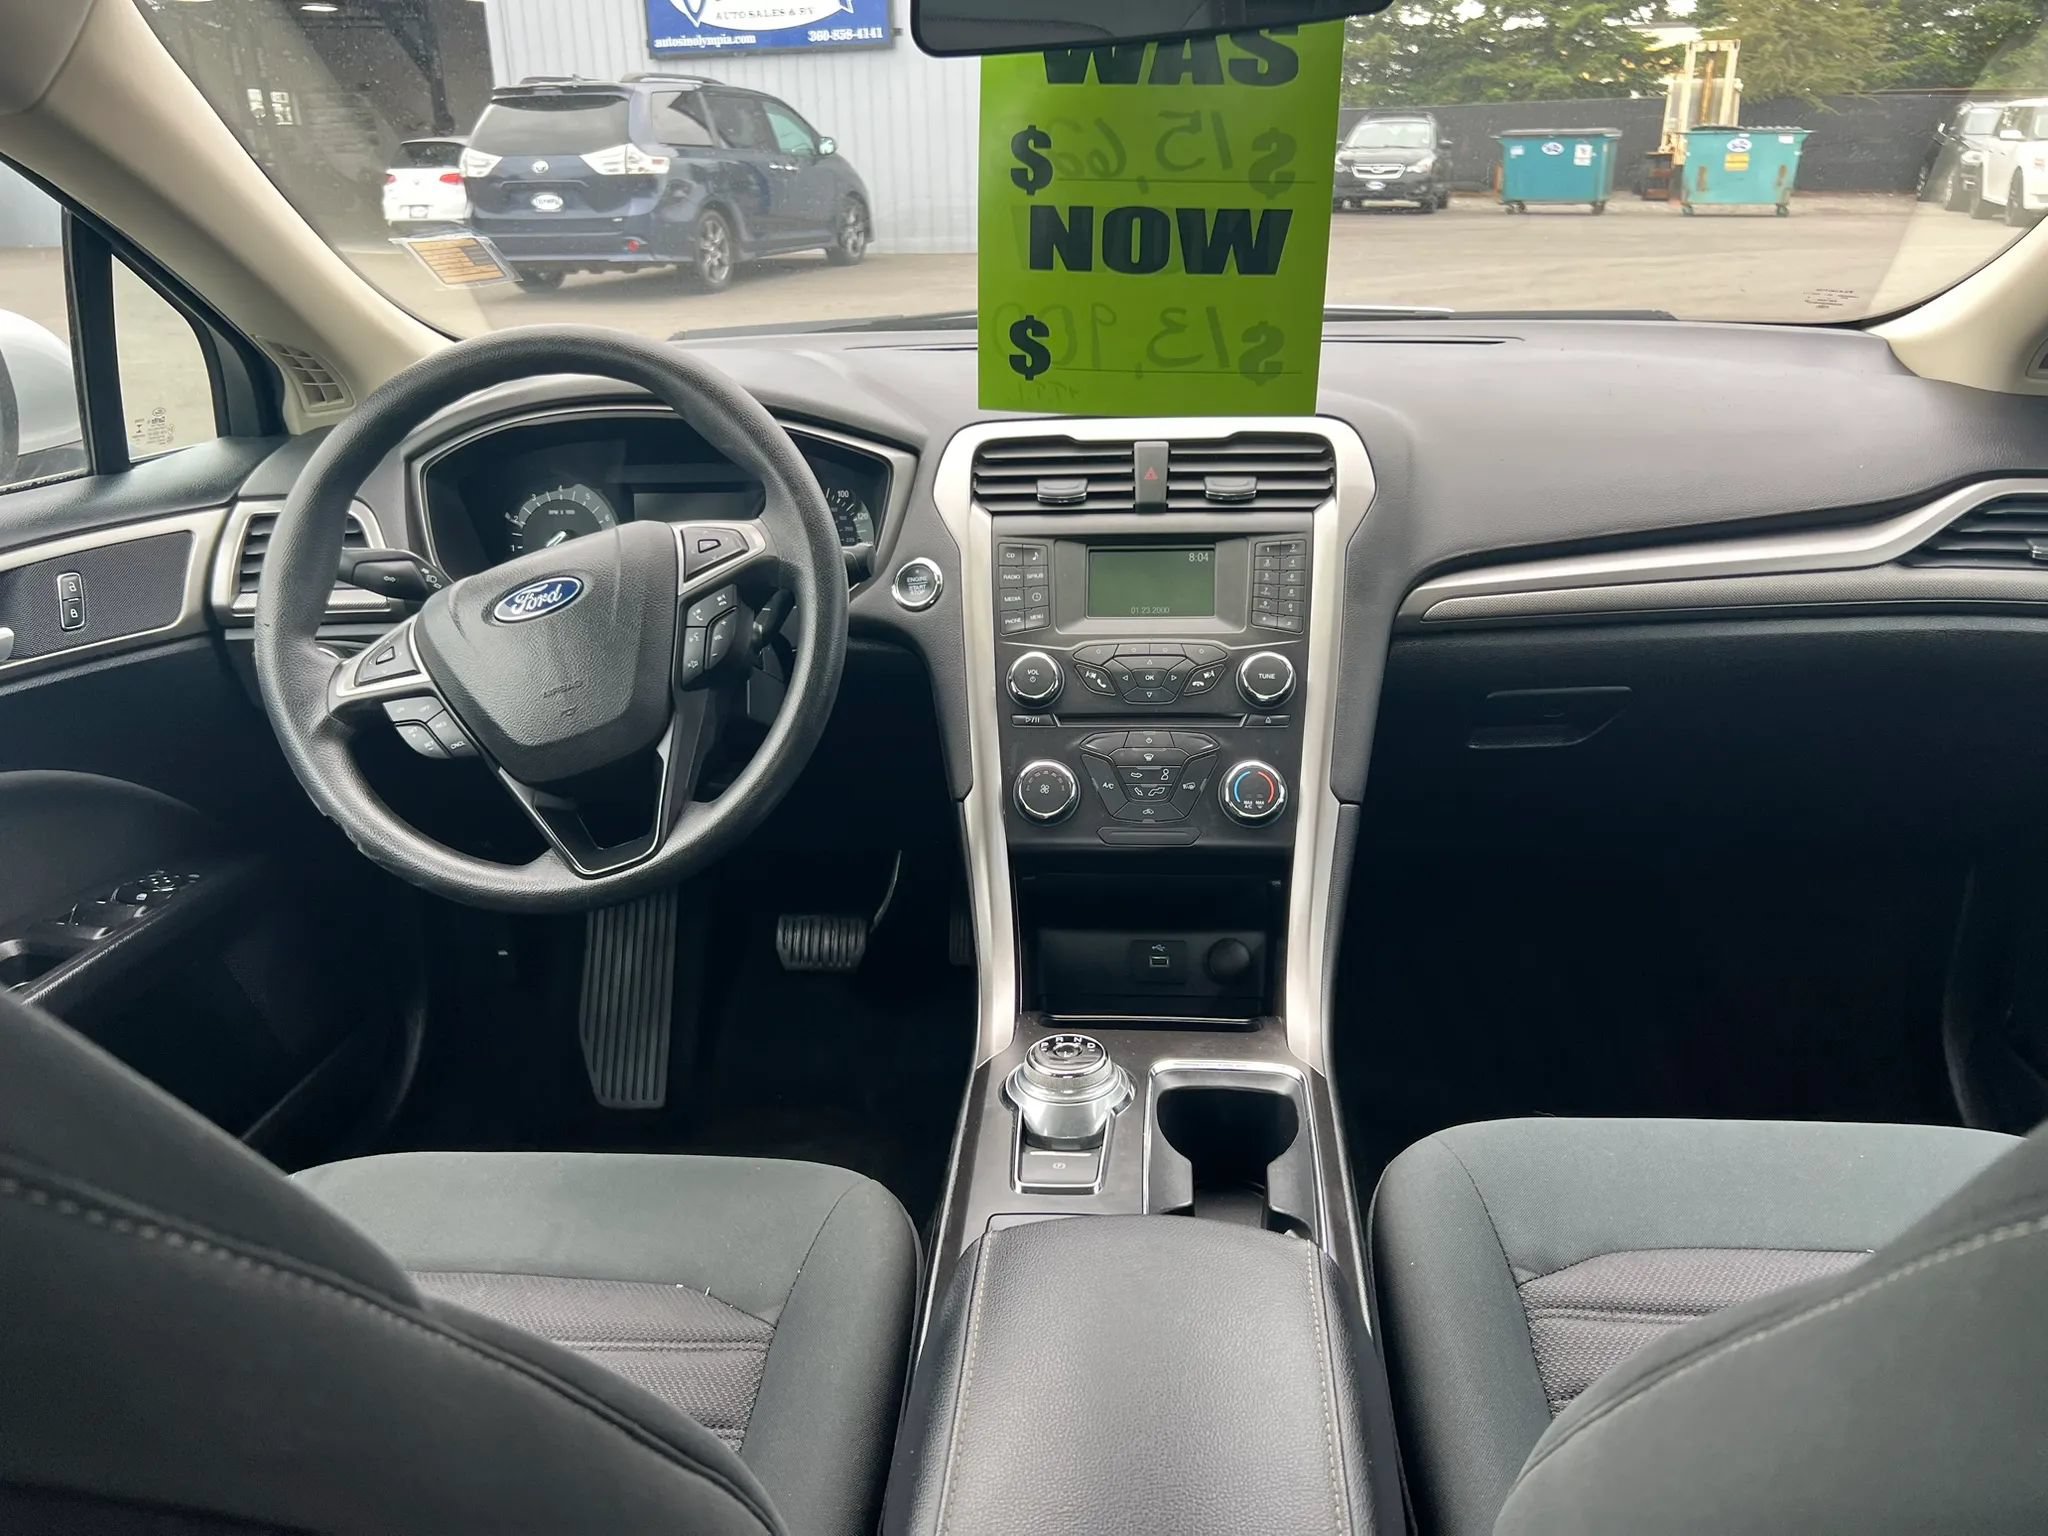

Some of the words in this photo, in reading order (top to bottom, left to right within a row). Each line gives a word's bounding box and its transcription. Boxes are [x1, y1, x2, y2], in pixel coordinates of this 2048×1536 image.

[716, 11, 746, 20] AUTO
[748, 8, 785, 18] SALES
[1043, 28, 1299, 87] WAS
[1010, 125, 1053, 195] $
[1029, 205, 1294, 275] NOW
[1008, 315, 1052, 380] $
[837, 490, 849, 498] 100
[857, 512, 869, 520] 120
[1188, 552, 1209, 562] 8:04
[511, 583, 563, 615] Ford
[1005, 617, 1022, 625] PHONE
